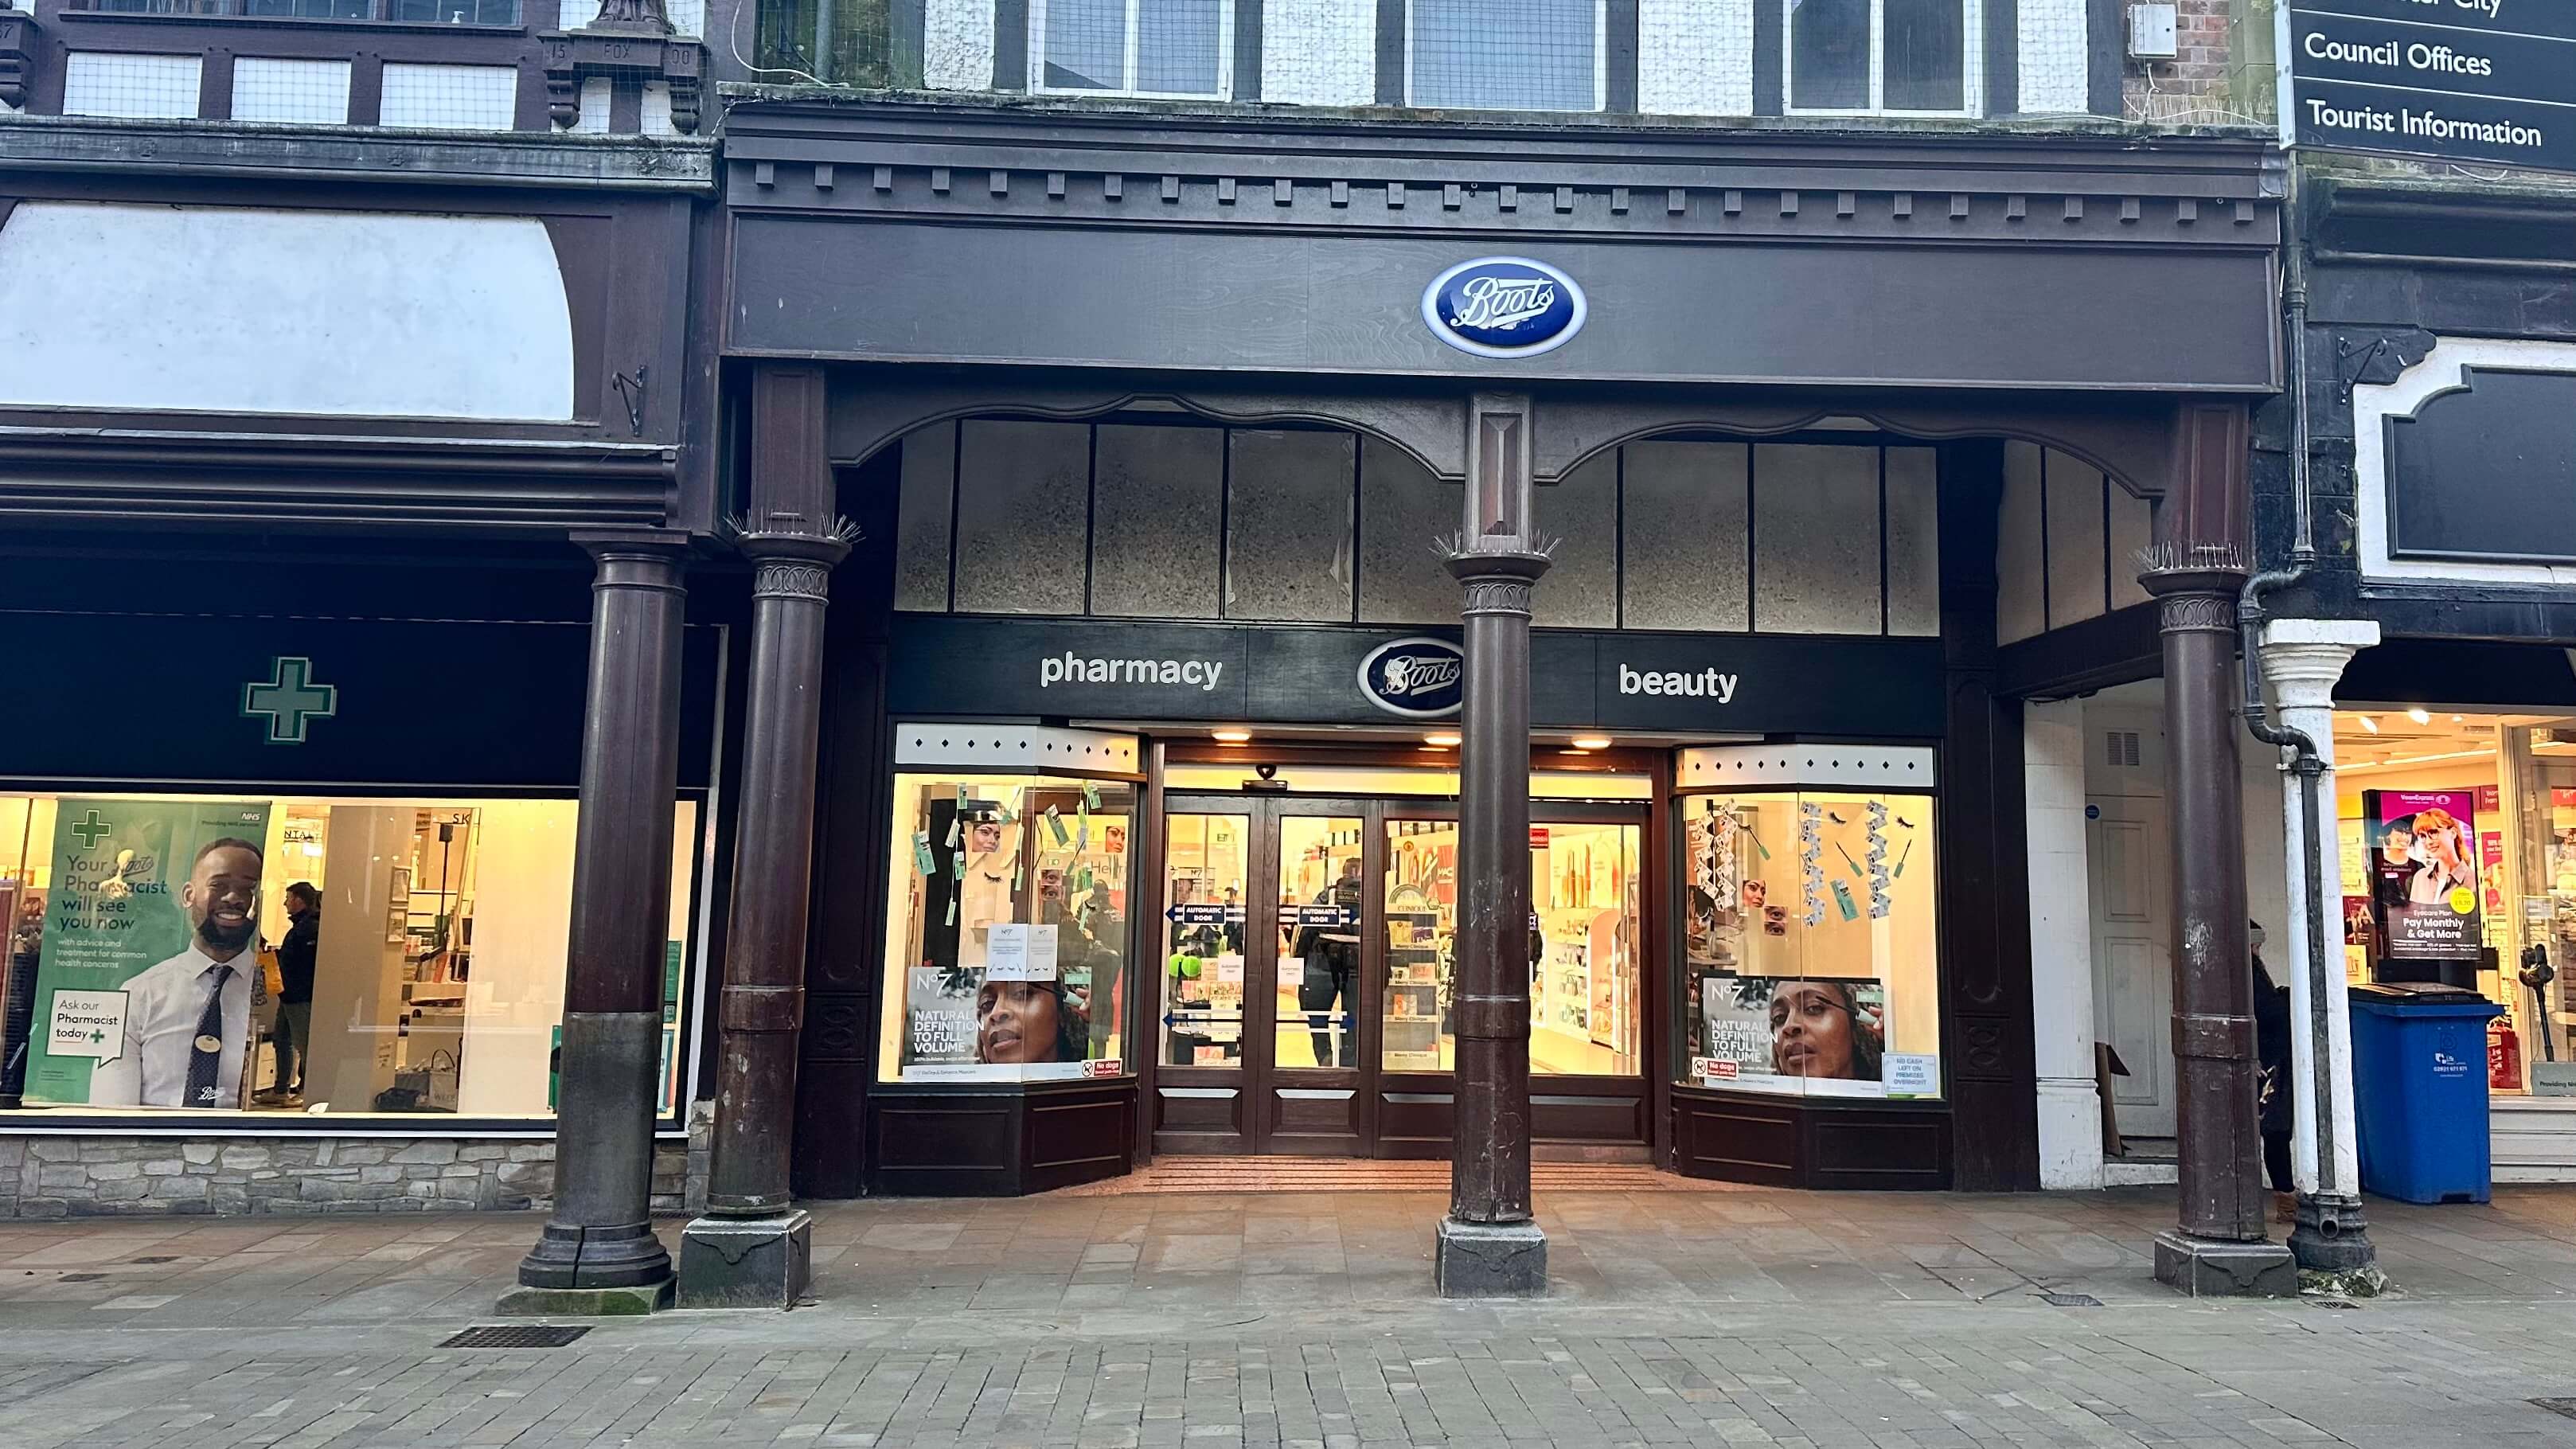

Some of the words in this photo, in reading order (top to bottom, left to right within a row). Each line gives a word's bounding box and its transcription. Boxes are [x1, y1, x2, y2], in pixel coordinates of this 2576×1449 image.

[604, 45, 631, 59] FOX
[2305, 33, 2398, 66] Council
[2407, 44, 2492, 76] Offices
[2306, 100, 2395, 133] Tourist
[2402, 108, 2542, 146] Information
[1450, 277, 1555, 329] Boots
[1041, 651, 1223, 691] pharmacy
[1379, 654, 1460, 696] Boots
[1619, 663, 1738, 704] beauty
[68, 855, 107, 871] Your
[108, 856, 154, 877] oots
[64, 875, 167, 894] Phaacist
[62, 896, 92, 911] will
[97, 901, 126, 912] see
[60, 917, 91, 932] you
[97, 919, 135, 930] now
[2403, 918, 2422, 928] Pay
[2424, 918, 2465, 930] Monthly
[2407, 929, 2415, 938] &
[2436, 930, 2462, 939] More
[57, 937, 75, 946] with
[76, 938, 103, 947] advice
[55, 958, 81, 967] health
[915, 974, 953, 998] No7
[1711, 985, 1746, 1008] No7
[59, 999, 79, 1009] Ask
[57, 1014, 118, 1025] Pharmacist
[915, 1010, 970, 1021] NATURAL
[914, 1021, 985, 1032] DEFINITION
[1711, 1020, 1764, 1032] NATURAL
[57, 1028, 88, 1041] today
[914, 1032, 931, 1042] TO
[933, 1032, 963, 1042] FULL
[1711, 1030, 1778, 1043] DEFINITION
[914, 1043, 966, 1053] VOLUME
[1711, 1041, 1728, 1050] TO
[1730, 1041, 1759, 1051] FULL
[2539, 1080, 2566, 1089] Providing
